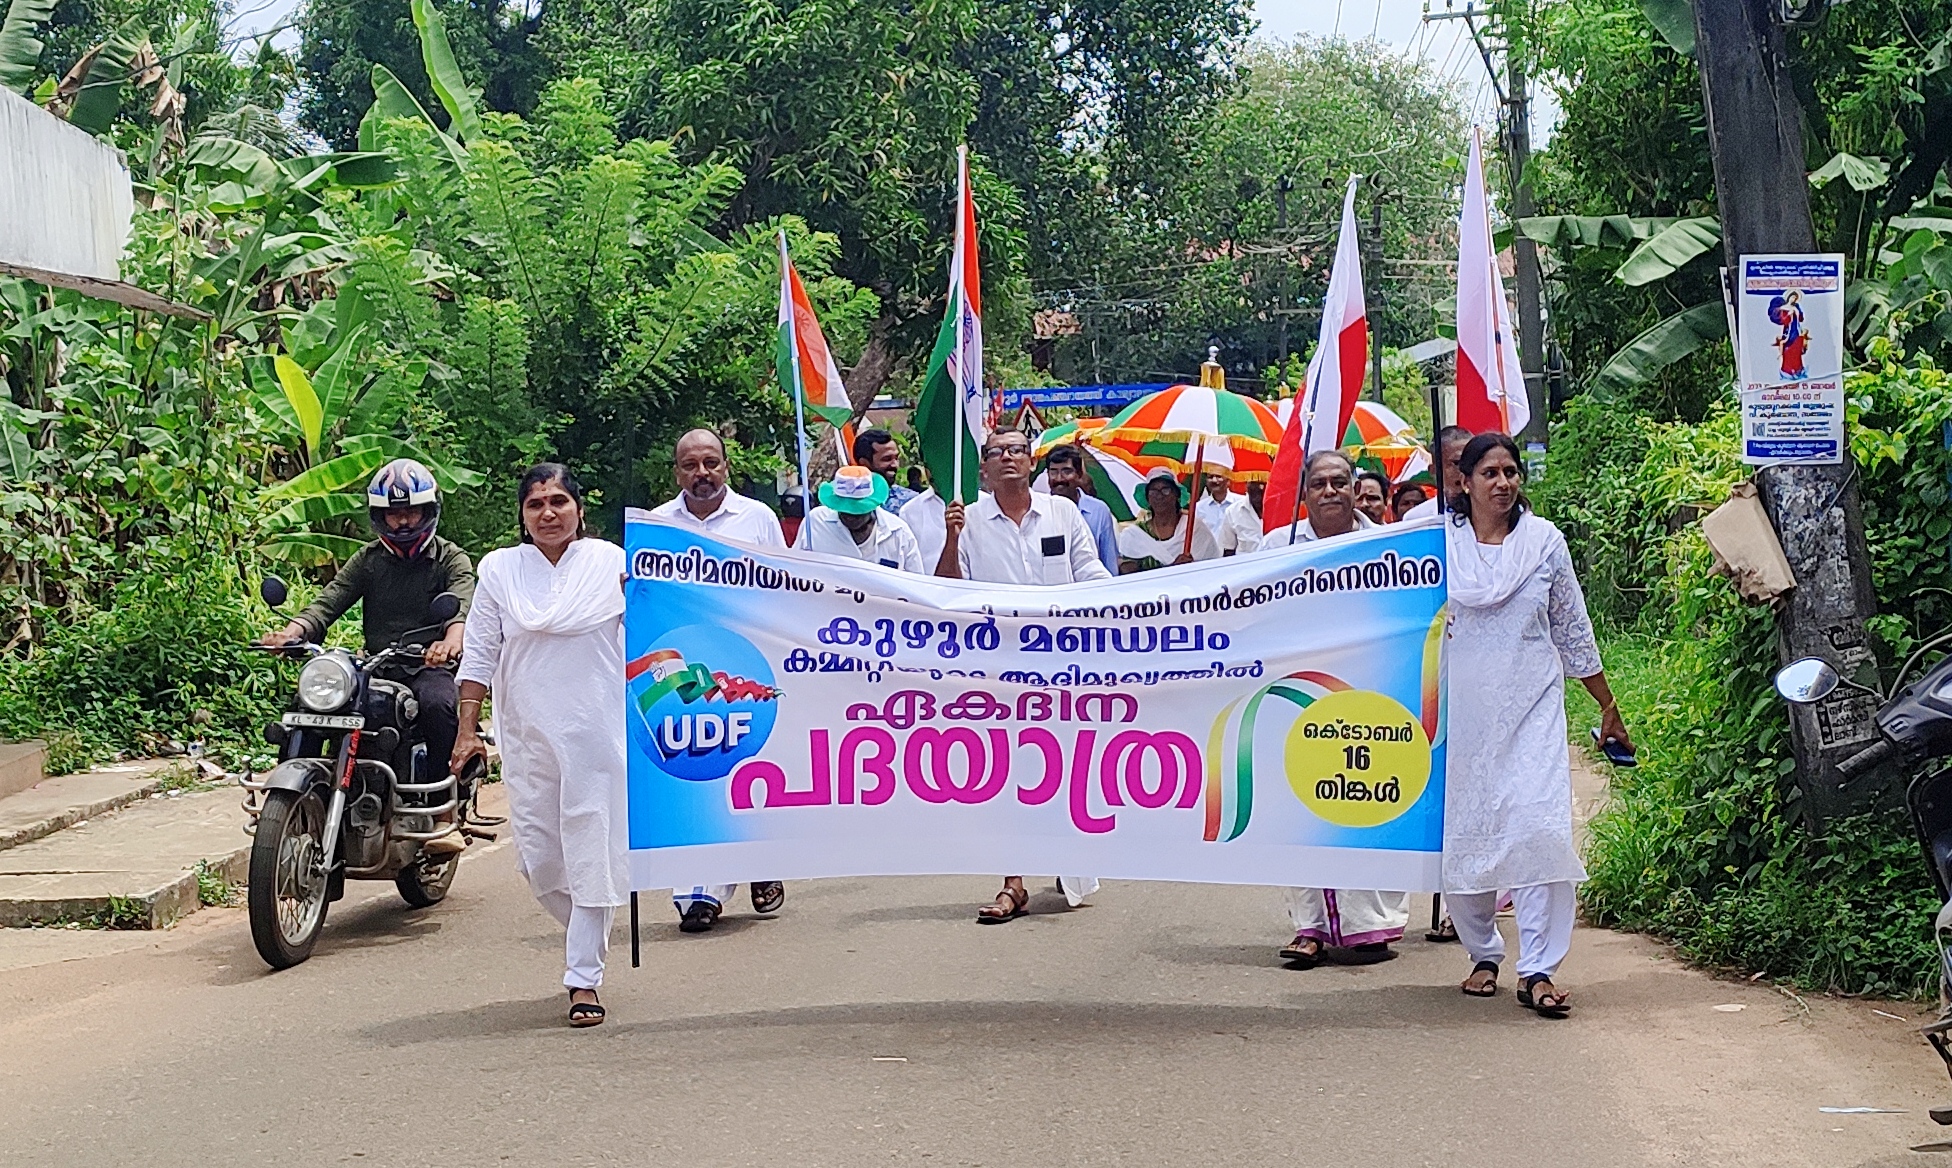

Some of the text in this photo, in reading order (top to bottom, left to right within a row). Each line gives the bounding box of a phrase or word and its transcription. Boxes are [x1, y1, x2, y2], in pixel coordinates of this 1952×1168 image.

[634, 548, 825, 593] അഴിമതിയിൽ
[1180, 552, 1441, 615] സർക്കാരിനെതിരെ
[816, 614, 1231, 659] കുഴൂർ മണ്ഡലം
[846, 688, 1139, 729] ഏകദിന
[659, 711, 754, 754] UDF
[1303, 719, 1414, 742] ഒക്ടോബർ
[1342, 745, 1371, 771] 16
[731, 726, 1204, 833] പദയാത്ര
[1315, 774, 1401, 804] തിങ്കൾ
